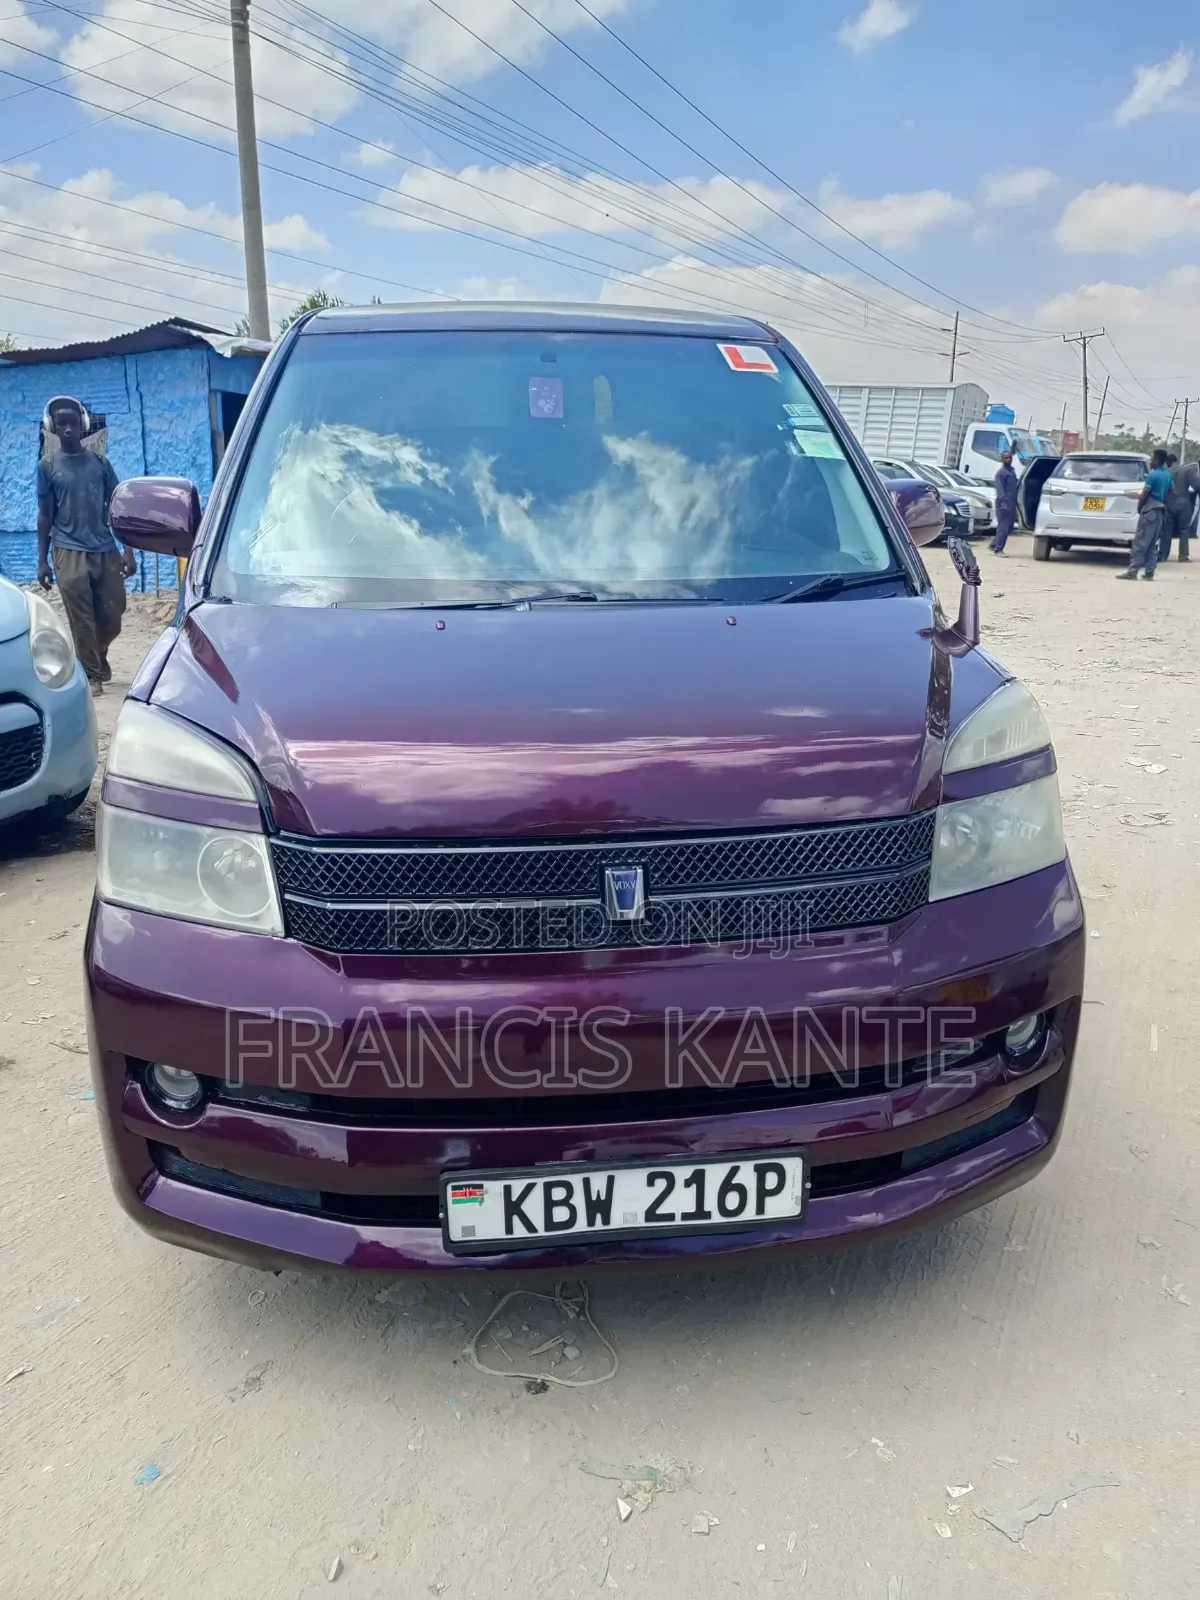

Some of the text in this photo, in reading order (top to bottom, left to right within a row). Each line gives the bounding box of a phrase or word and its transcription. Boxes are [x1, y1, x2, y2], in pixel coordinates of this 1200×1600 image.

[722, 346, 774, 371] L
[613, 880, 636, 890] VOXY
[502, 1174, 616, 1236] KBW
[643, 1161, 787, 1224] 216P
